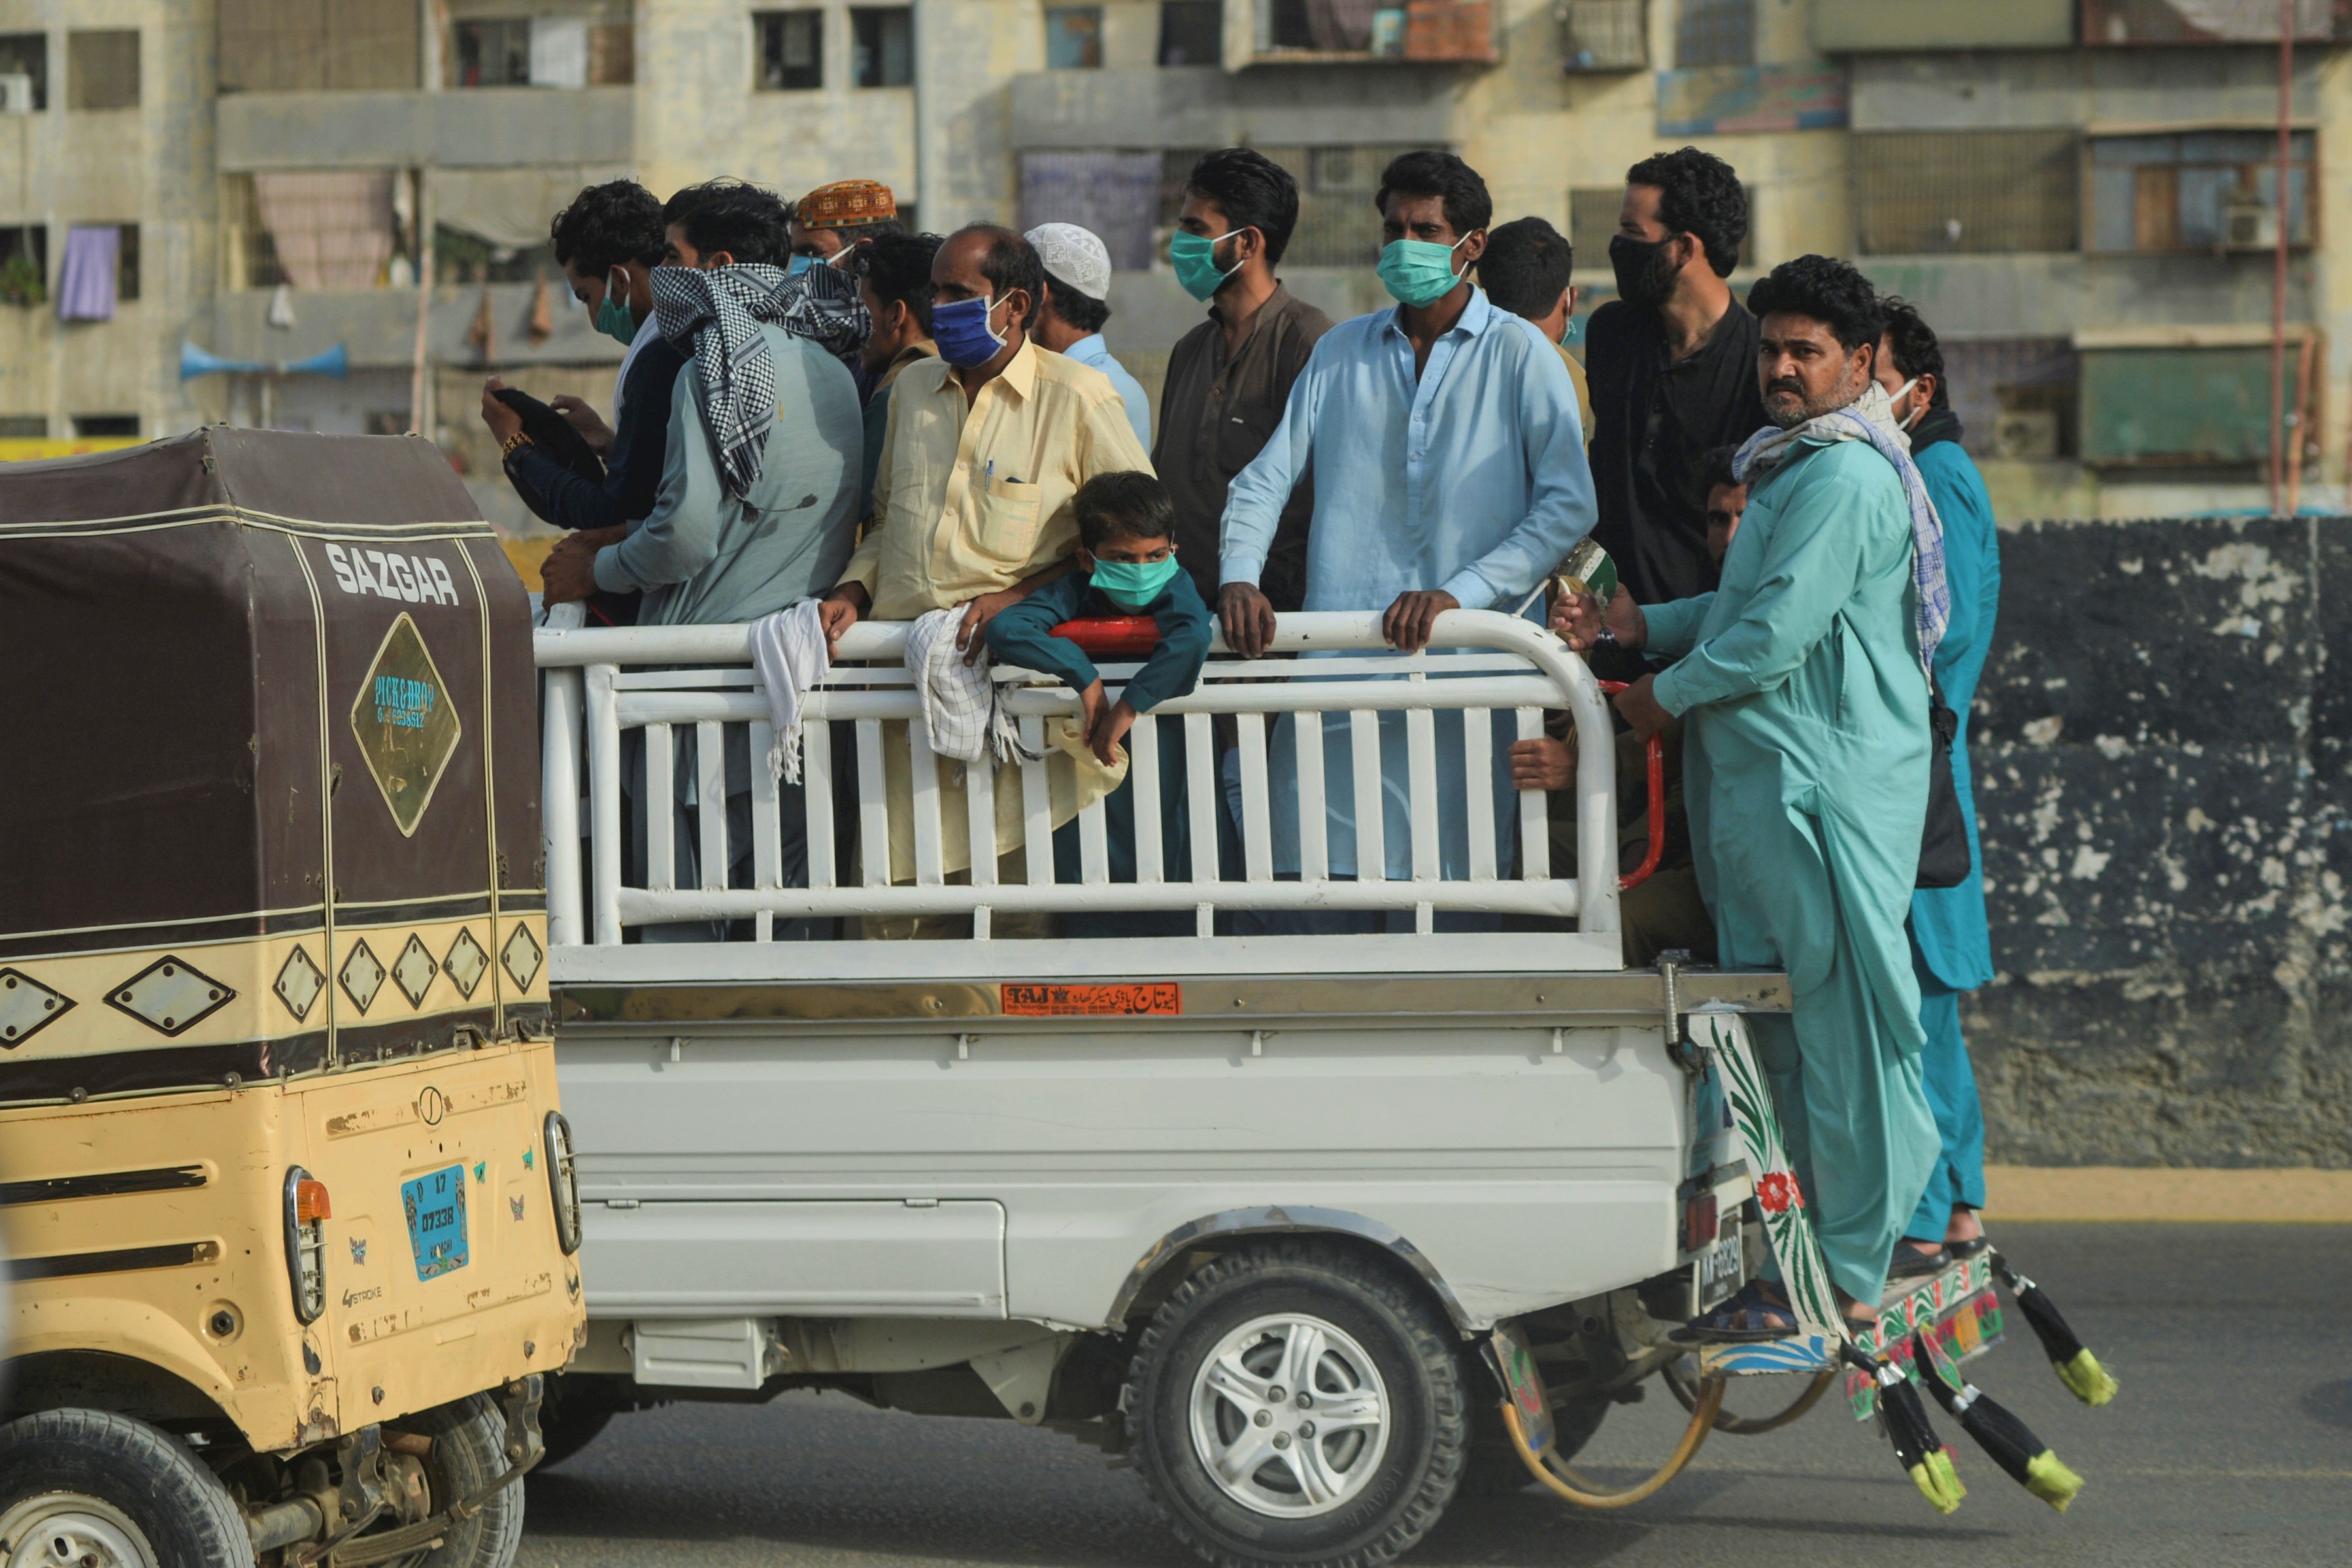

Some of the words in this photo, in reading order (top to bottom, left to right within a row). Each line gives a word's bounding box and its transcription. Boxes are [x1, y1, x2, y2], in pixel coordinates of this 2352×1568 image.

[325, 543, 459, 606] SAZGAR
[1007, 987, 1049, 1003] TAJ
[1133, 986, 1162, 1014] تاج
[436, 1174, 446, 1194] 17
[422, 1206, 454, 1232] 07338
